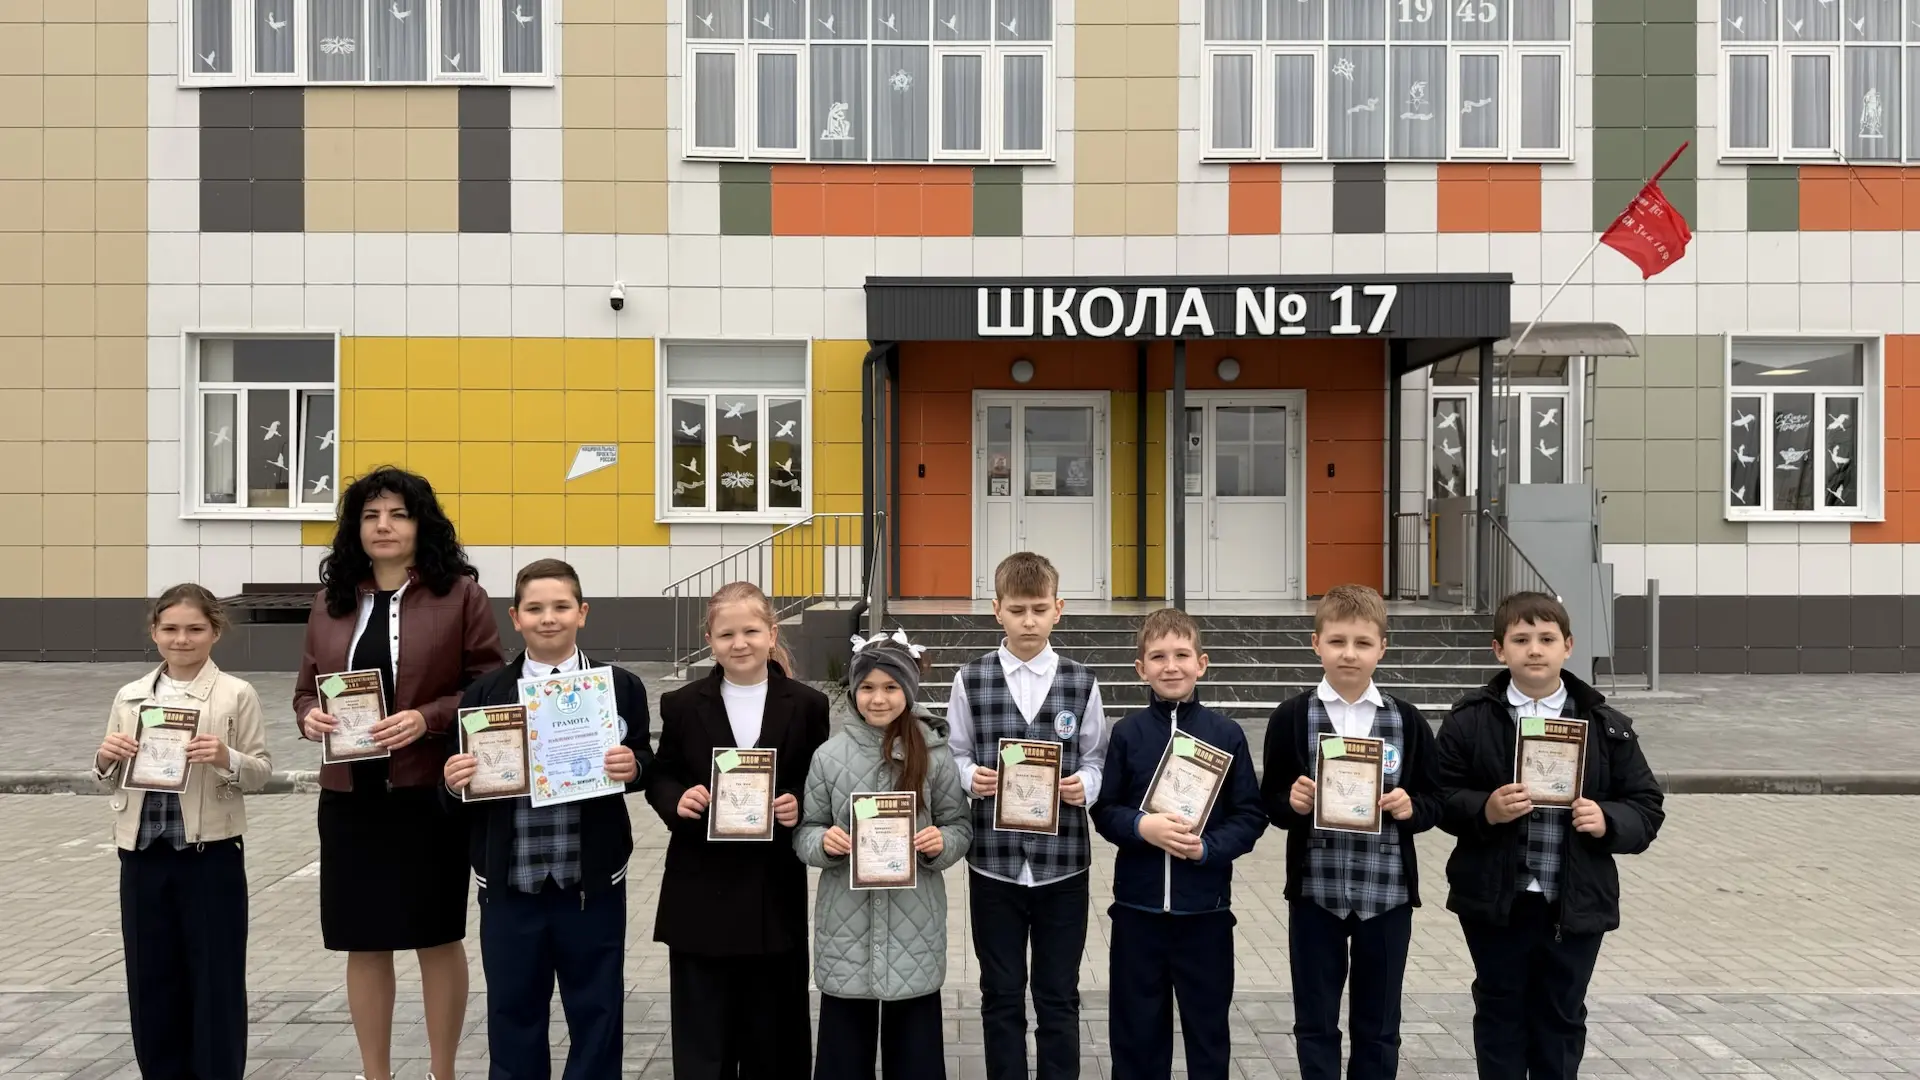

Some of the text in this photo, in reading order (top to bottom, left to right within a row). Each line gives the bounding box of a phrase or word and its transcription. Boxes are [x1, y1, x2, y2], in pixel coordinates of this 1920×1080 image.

[977, 285, 1398, 338] ШКОЛА № 17
[552, 717, 590, 728] ГРАМОТА
